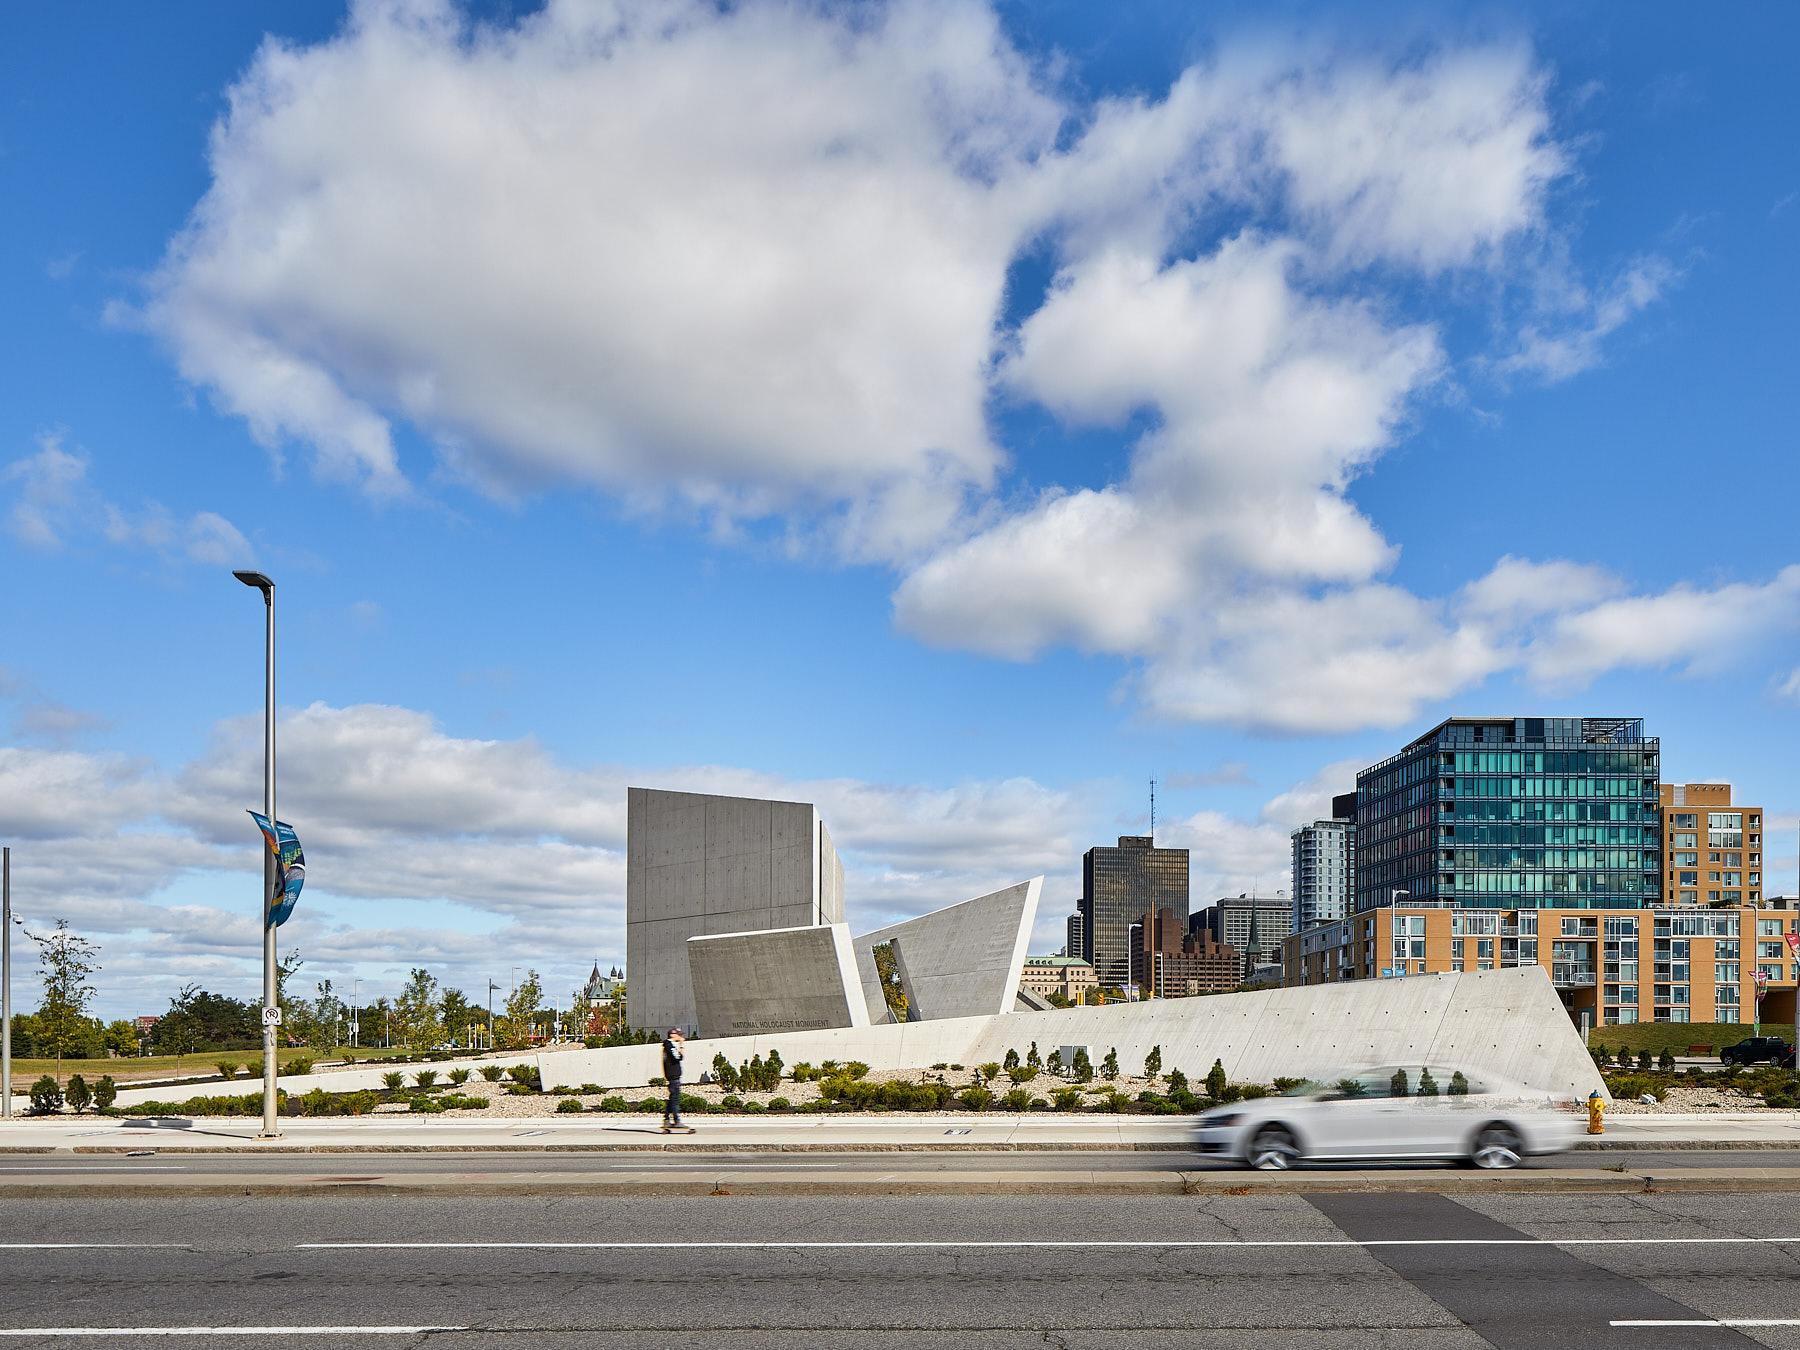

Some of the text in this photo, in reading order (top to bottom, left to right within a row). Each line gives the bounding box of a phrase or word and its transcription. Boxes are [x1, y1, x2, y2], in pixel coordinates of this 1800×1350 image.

[732, 1019, 829, 1029] NATIONAL HOLOCAUST MONUMENT
